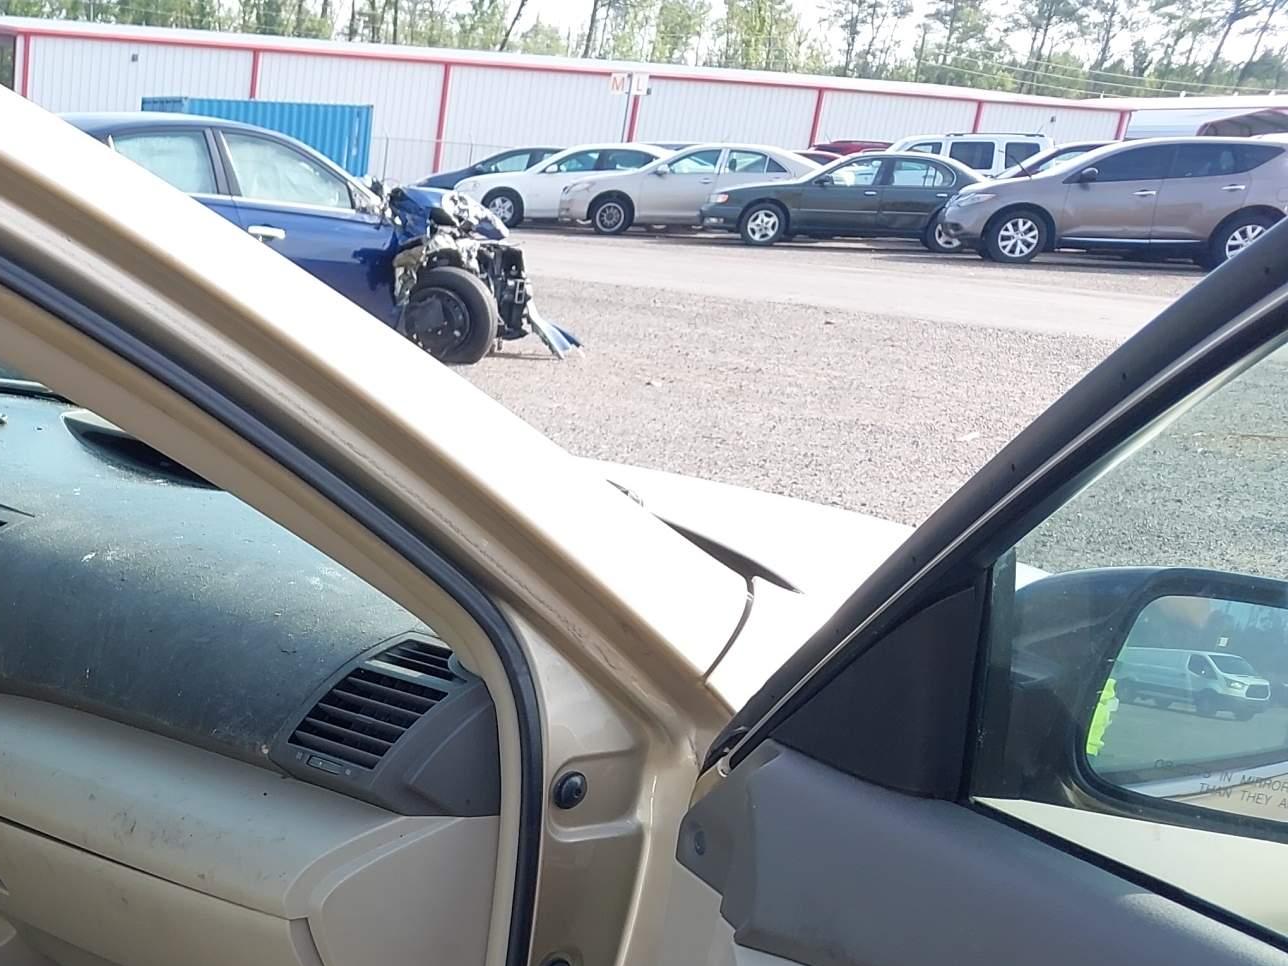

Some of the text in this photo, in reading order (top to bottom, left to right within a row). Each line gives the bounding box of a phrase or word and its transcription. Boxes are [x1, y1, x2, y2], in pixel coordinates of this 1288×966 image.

[612, 76, 625, 91] M
[636, 77, 643, 91] L
[1219, 771, 1233, 783] IN
[1200, 782, 1233, 799] THAN
[1239, 789, 1272, 805] THEY
